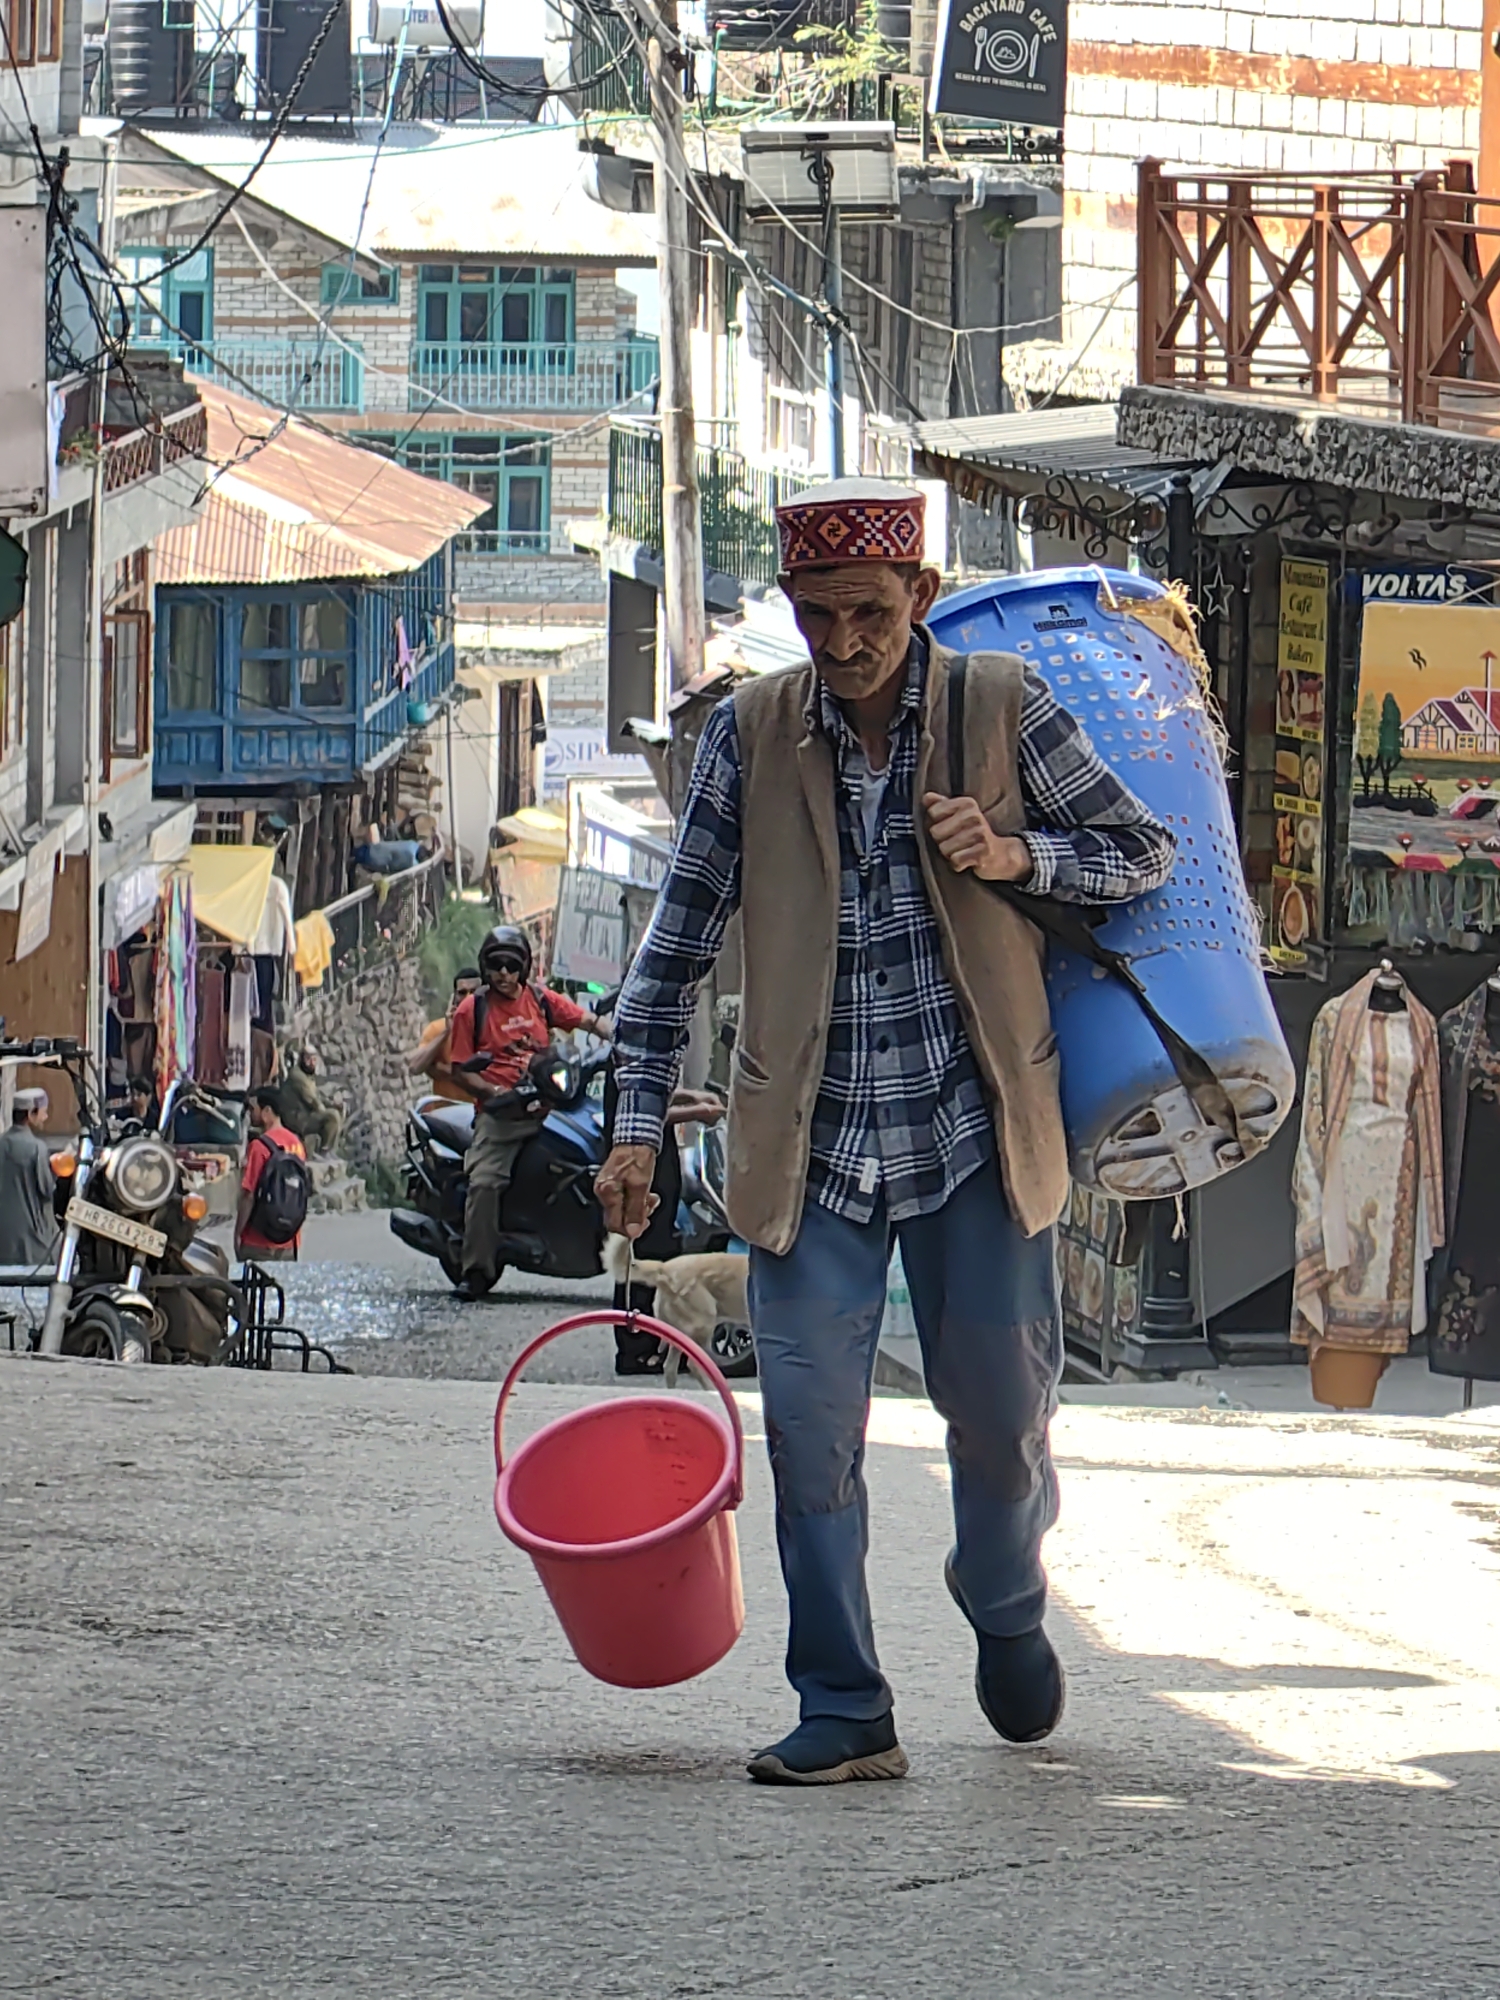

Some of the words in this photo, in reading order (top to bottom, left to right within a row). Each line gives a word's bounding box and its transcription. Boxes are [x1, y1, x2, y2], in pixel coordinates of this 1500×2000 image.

[959, 0, 1026, 33] BACKYARD
[1028, 8, 1057, 43] CAFE
[84, 1209, 100, 1225] HR
[100, 1215, 115, 1231] 26
